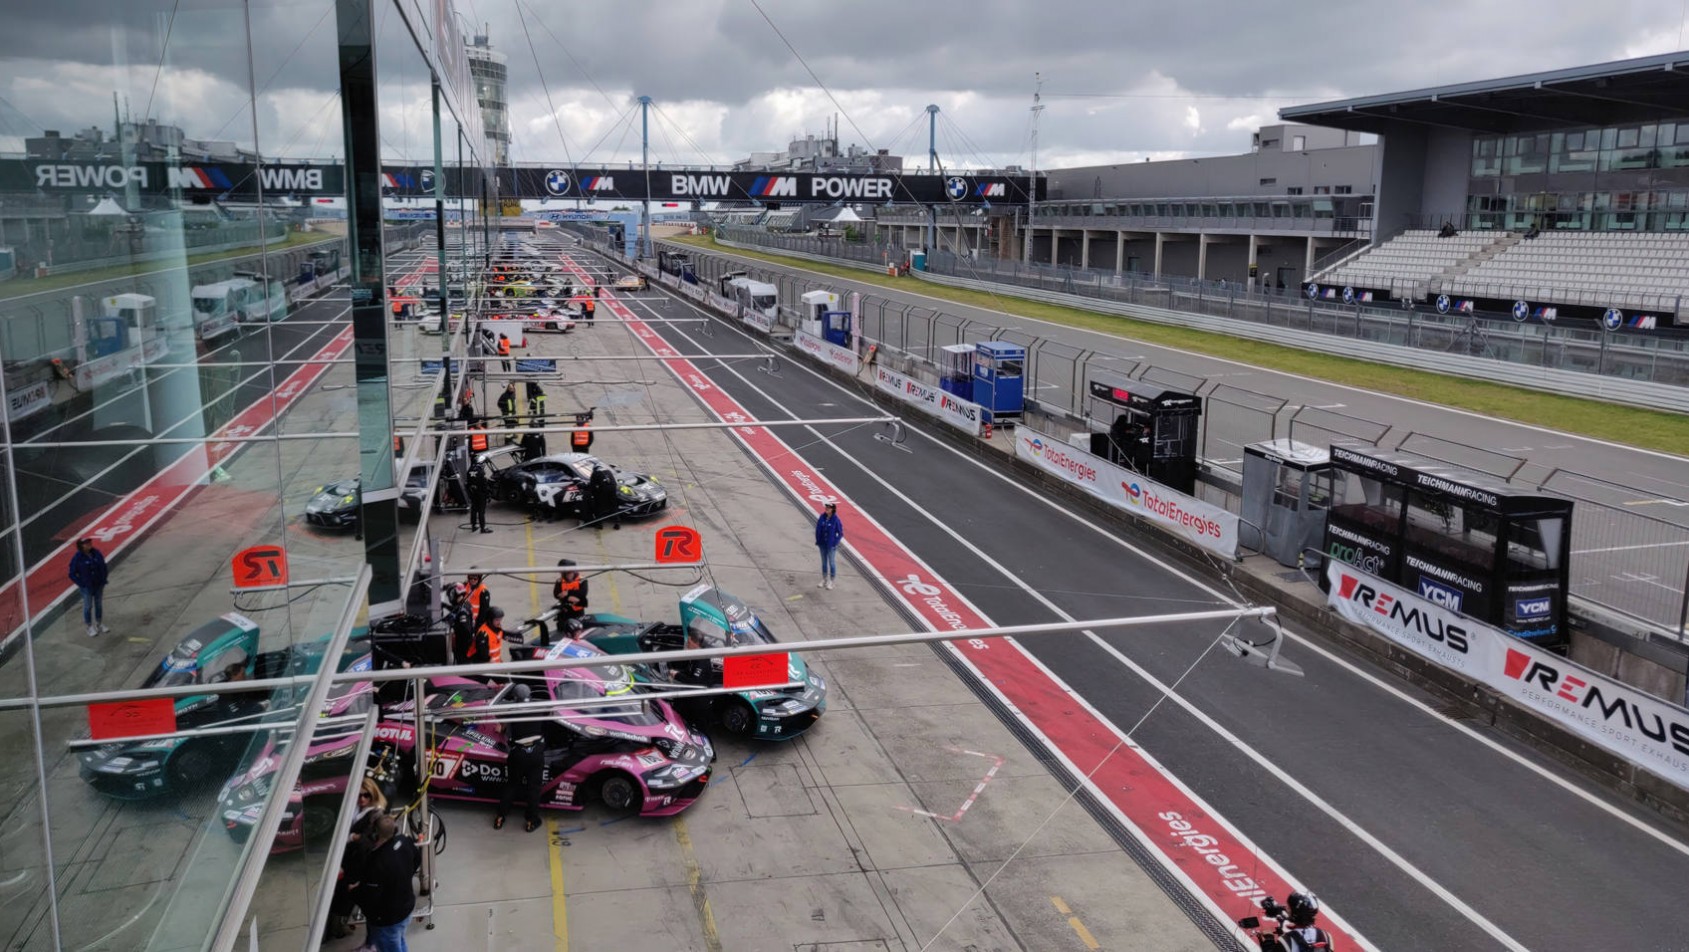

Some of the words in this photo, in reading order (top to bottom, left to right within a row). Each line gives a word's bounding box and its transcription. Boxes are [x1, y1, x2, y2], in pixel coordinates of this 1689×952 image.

[671, 175, 731, 196] BMW
[811, 177, 893, 198] POWER
[911, 384, 936, 403] REMUS
[946, 399, 976, 421] REMUS
[1044, 444, 1097, 482] TotalEnergies
[1334, 448, 1399, 477] TEICHMANNRACING
[1417, 474, 1498, 507] TEICHMANNRACING
[1143, 489, 1222, 539] TotalEnergies
[1328, 524, 1391, 556] TEICHMANNRACING
[1406, 555, 1483, 593] TEICHMANNRACING
[1421, 582, 1461, 612] YCM
[1519, 600, 1550, 614] YCM
[1353, 583, 1469, 654] REMUS
[1524, 661, 1689, 757] REMUS
[1521, 688, 1598, 729] PERFORMANCE
[1601, 724, 1637, 746] SPORT
[1640, 743, 1688, 772] EXHAUS
